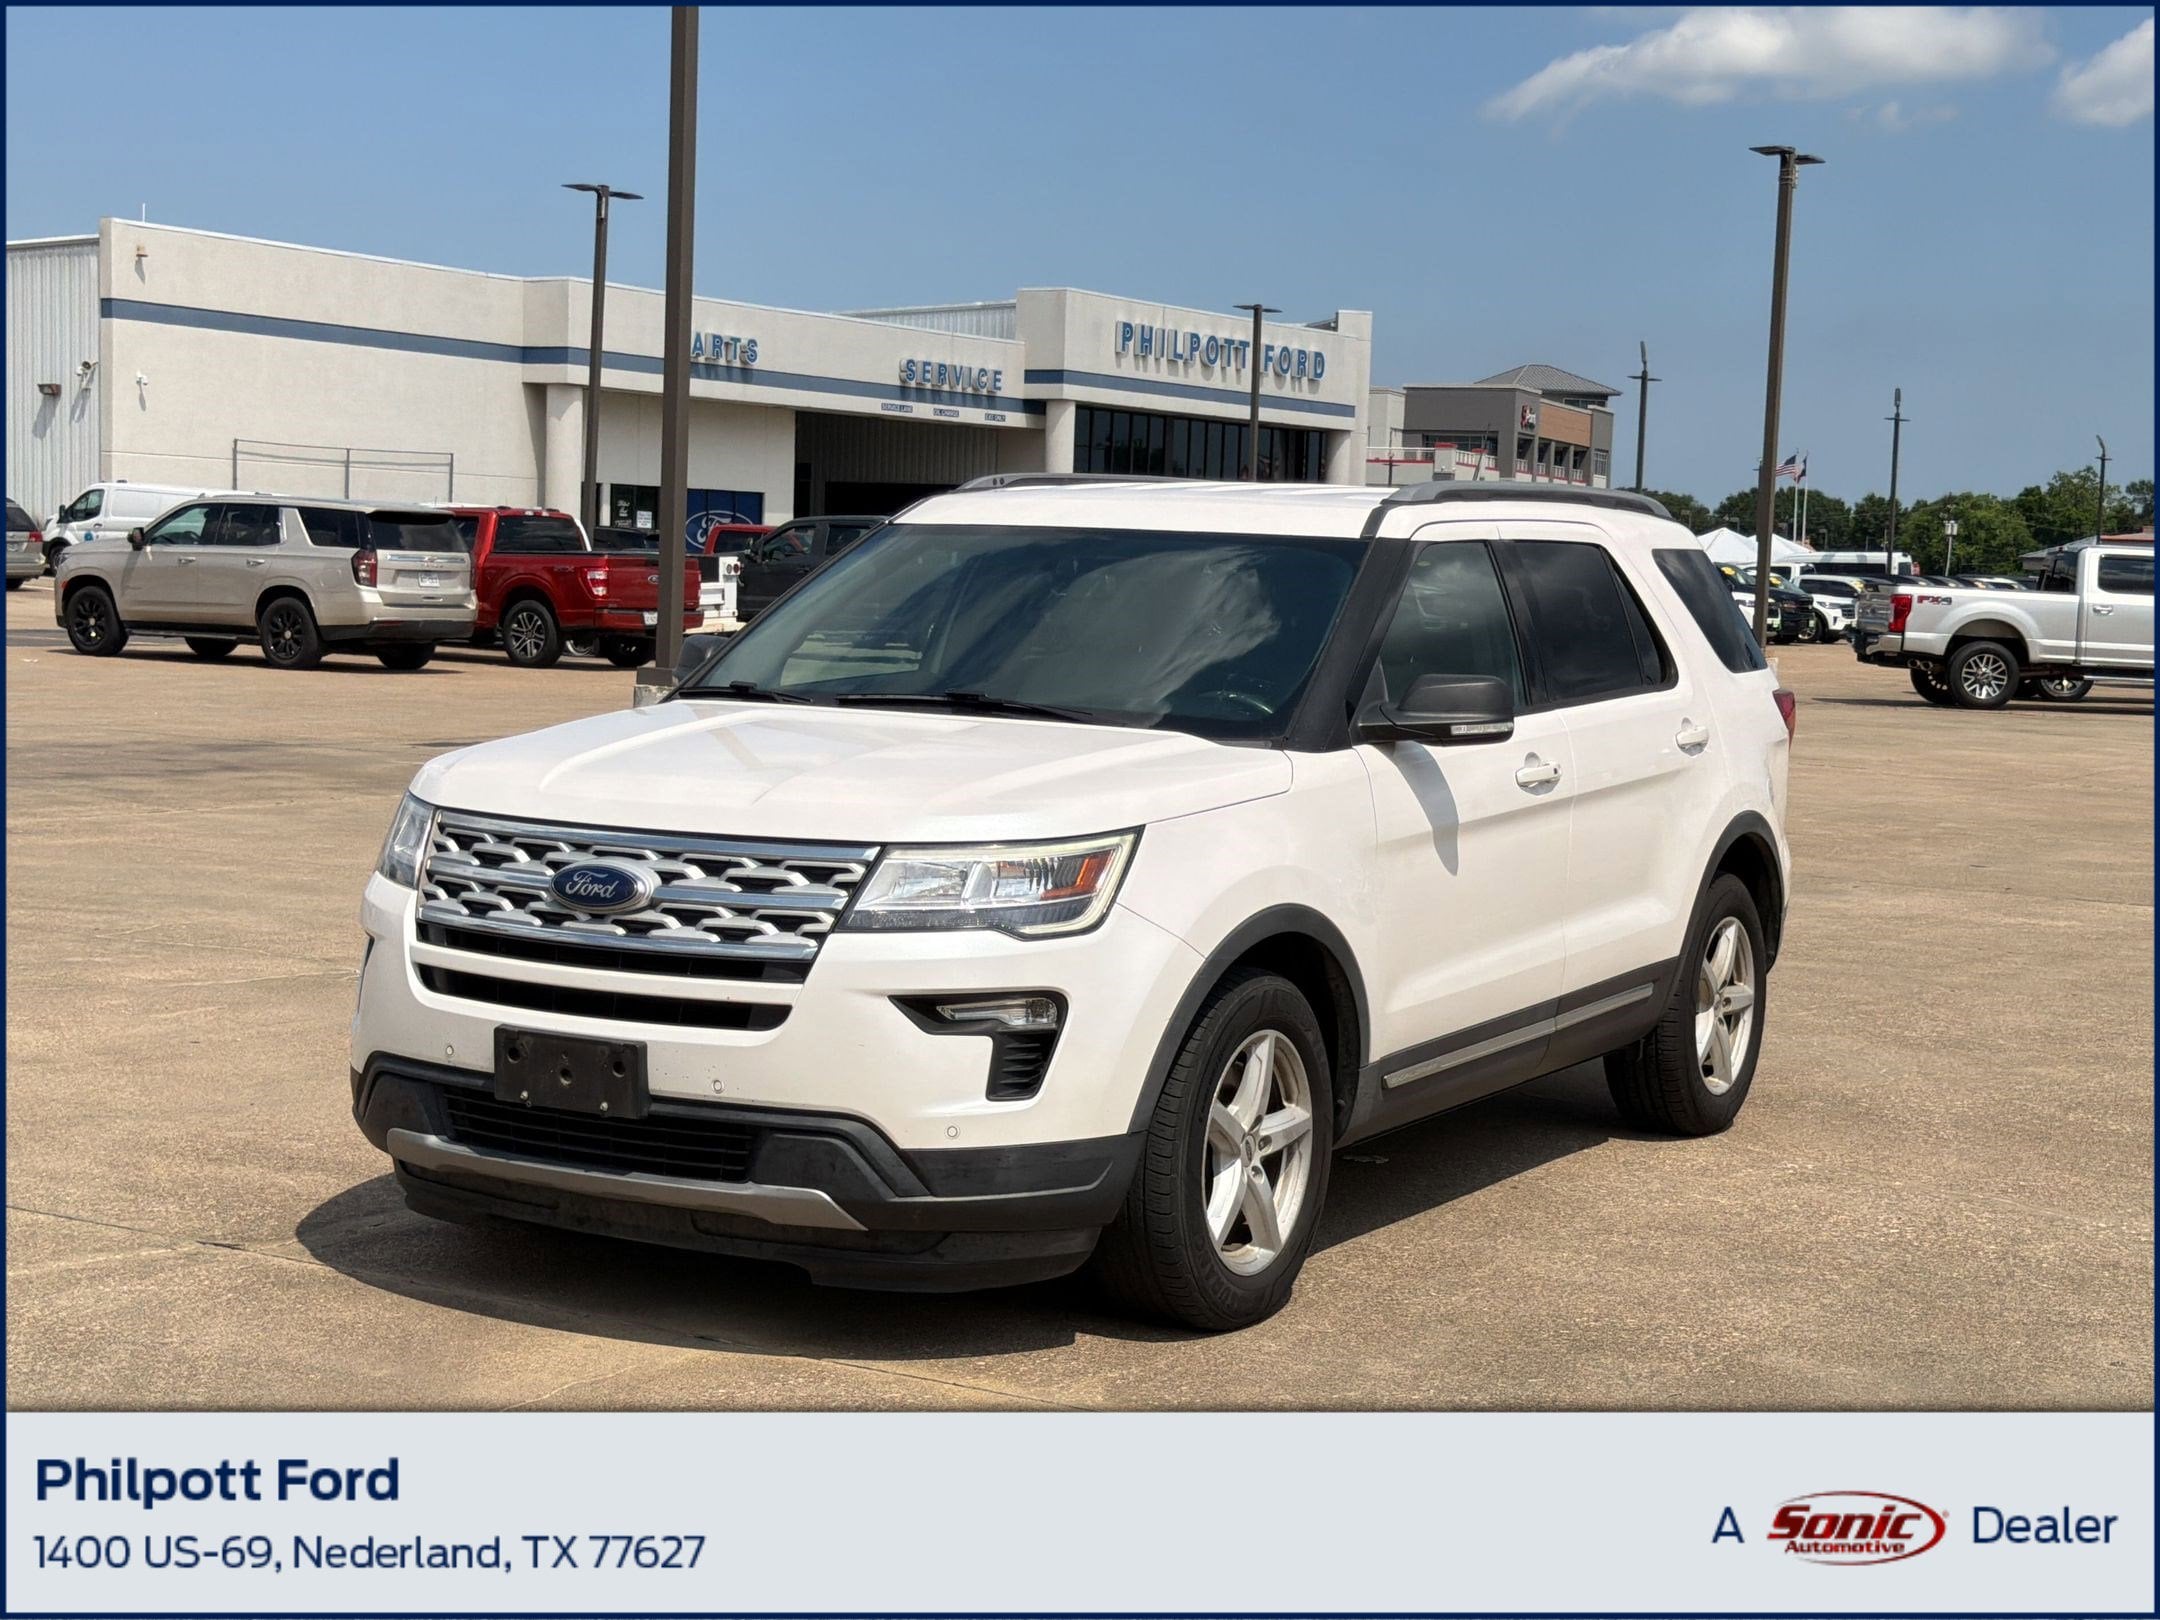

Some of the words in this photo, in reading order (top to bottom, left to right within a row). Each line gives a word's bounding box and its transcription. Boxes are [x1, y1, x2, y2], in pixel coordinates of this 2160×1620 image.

[691, 331, 759, 364] ARTS
[1116, 321, 1250, 370] PHILPOTT
[1263, 343, 1325, 380] FORD
[902, 359, 1002, 391] SERVICE
[566, 870, 619, 898] Ford
